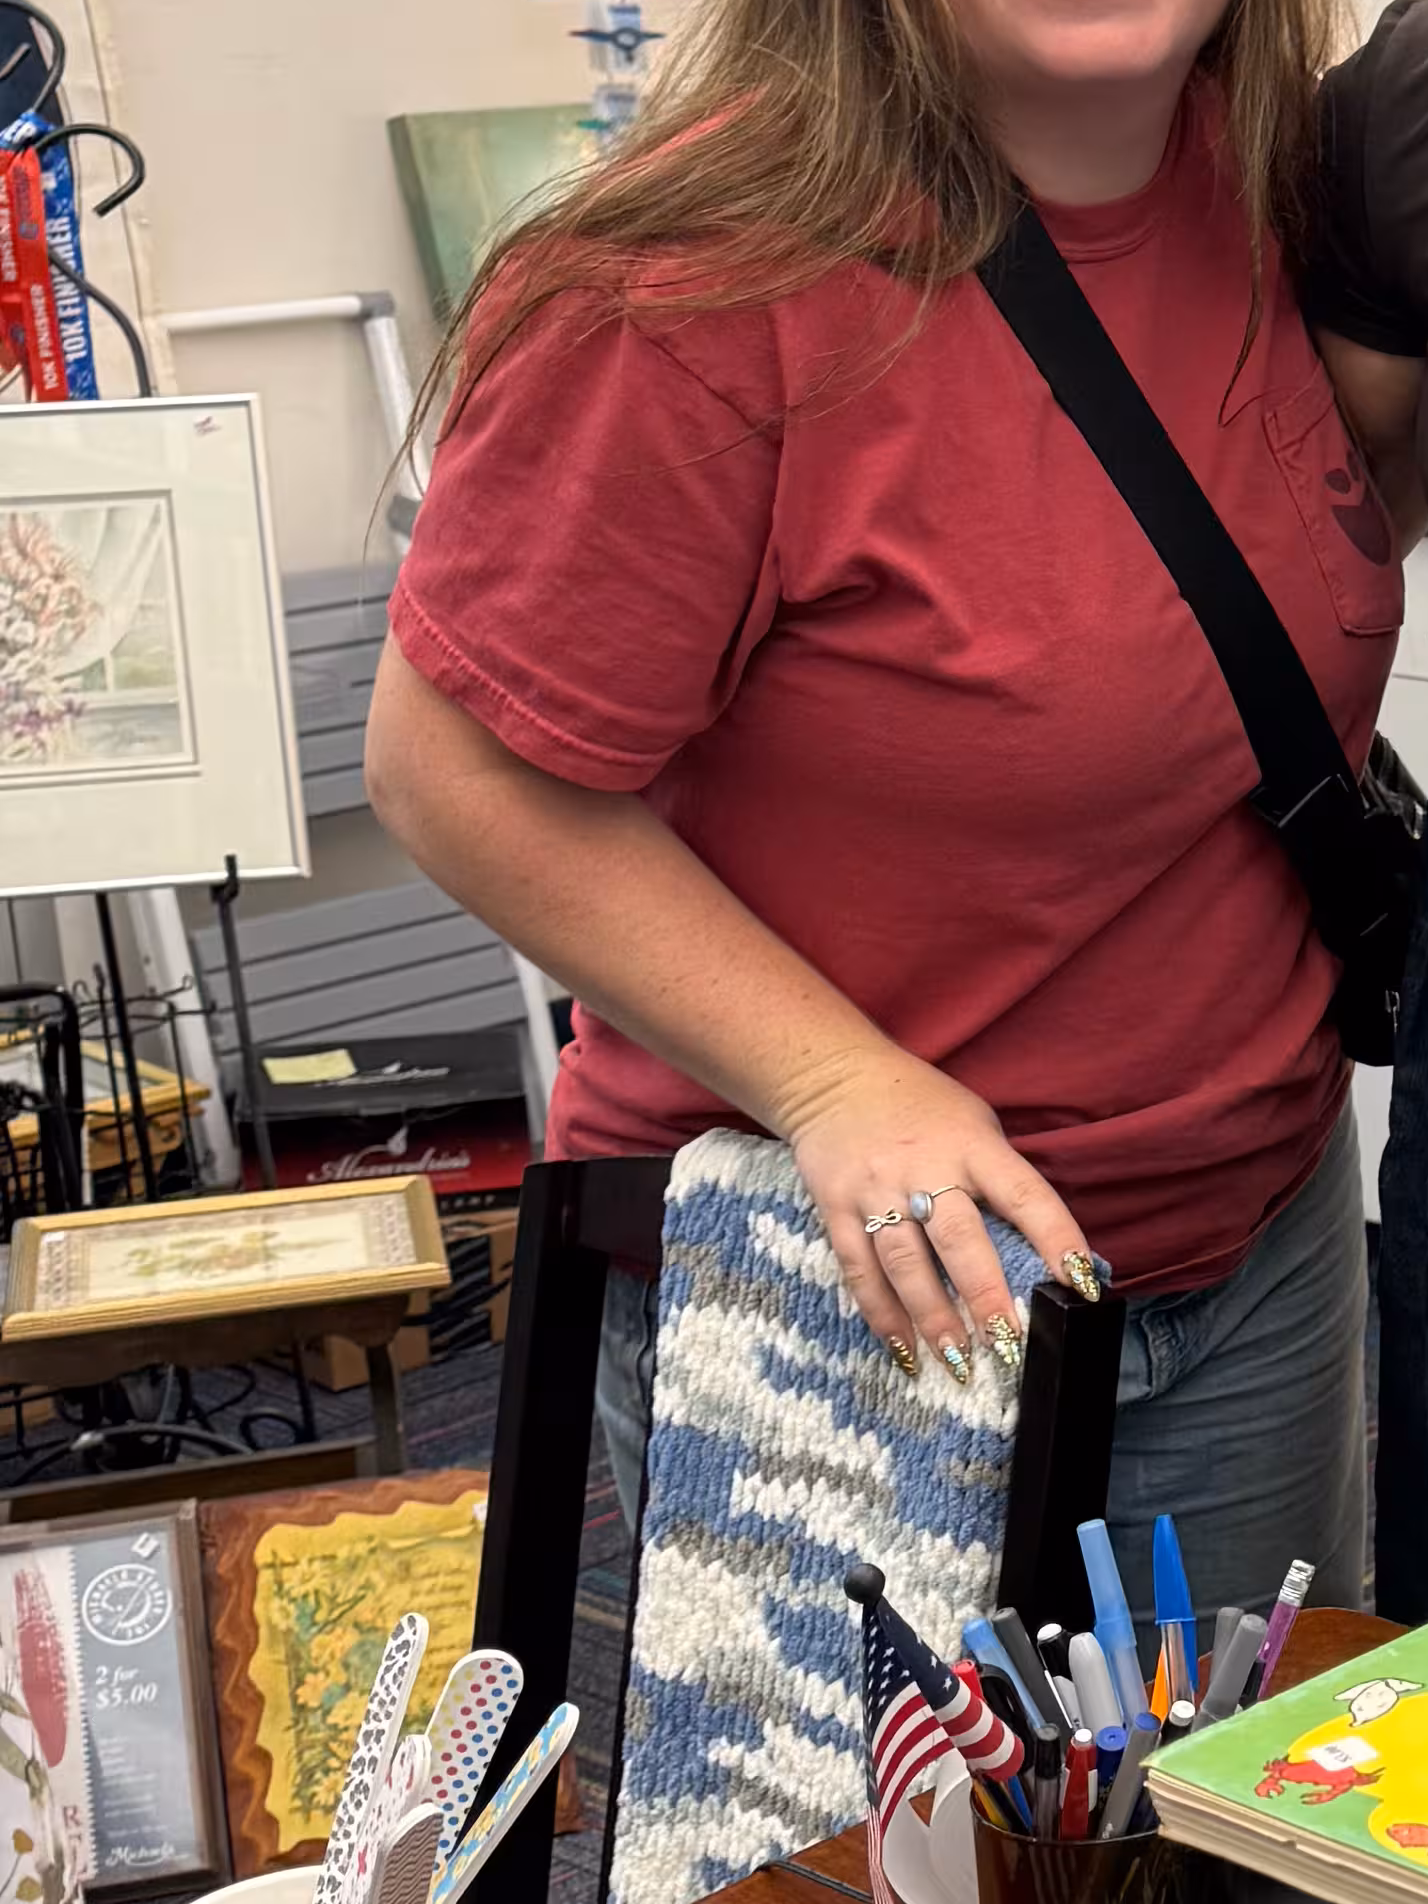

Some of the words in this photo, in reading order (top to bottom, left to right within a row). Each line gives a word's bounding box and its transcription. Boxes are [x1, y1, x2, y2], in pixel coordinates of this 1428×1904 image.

[95, 1665, 107, 1685] 2
[110, 1665, 139, 1684] for
[95, 1682, 158, 1708] $5.00
